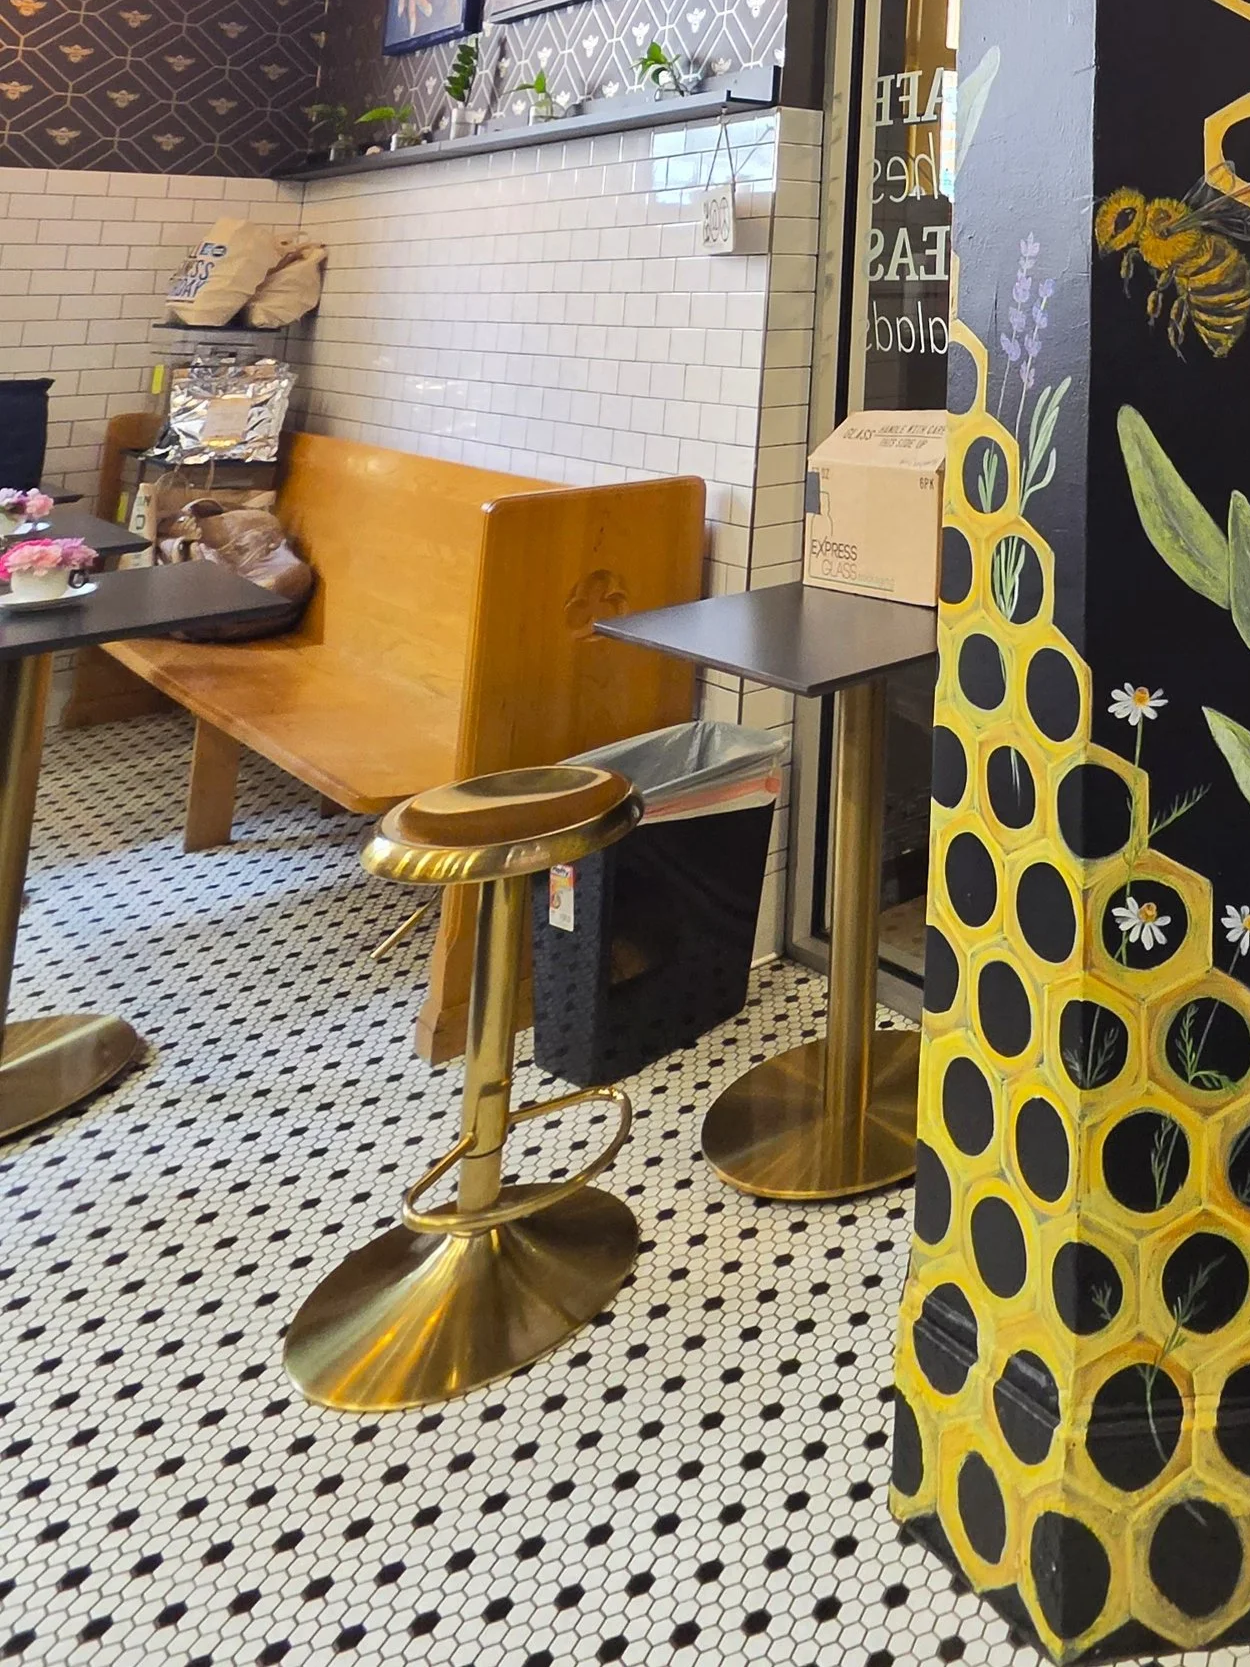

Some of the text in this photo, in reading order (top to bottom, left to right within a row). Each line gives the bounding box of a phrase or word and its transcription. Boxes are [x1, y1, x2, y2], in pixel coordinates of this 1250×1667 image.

[919, 477, 935, 490] 6PK
[811, 536, 857, 561] EXPRESS
[821, 558, 858, 581] GLASS
